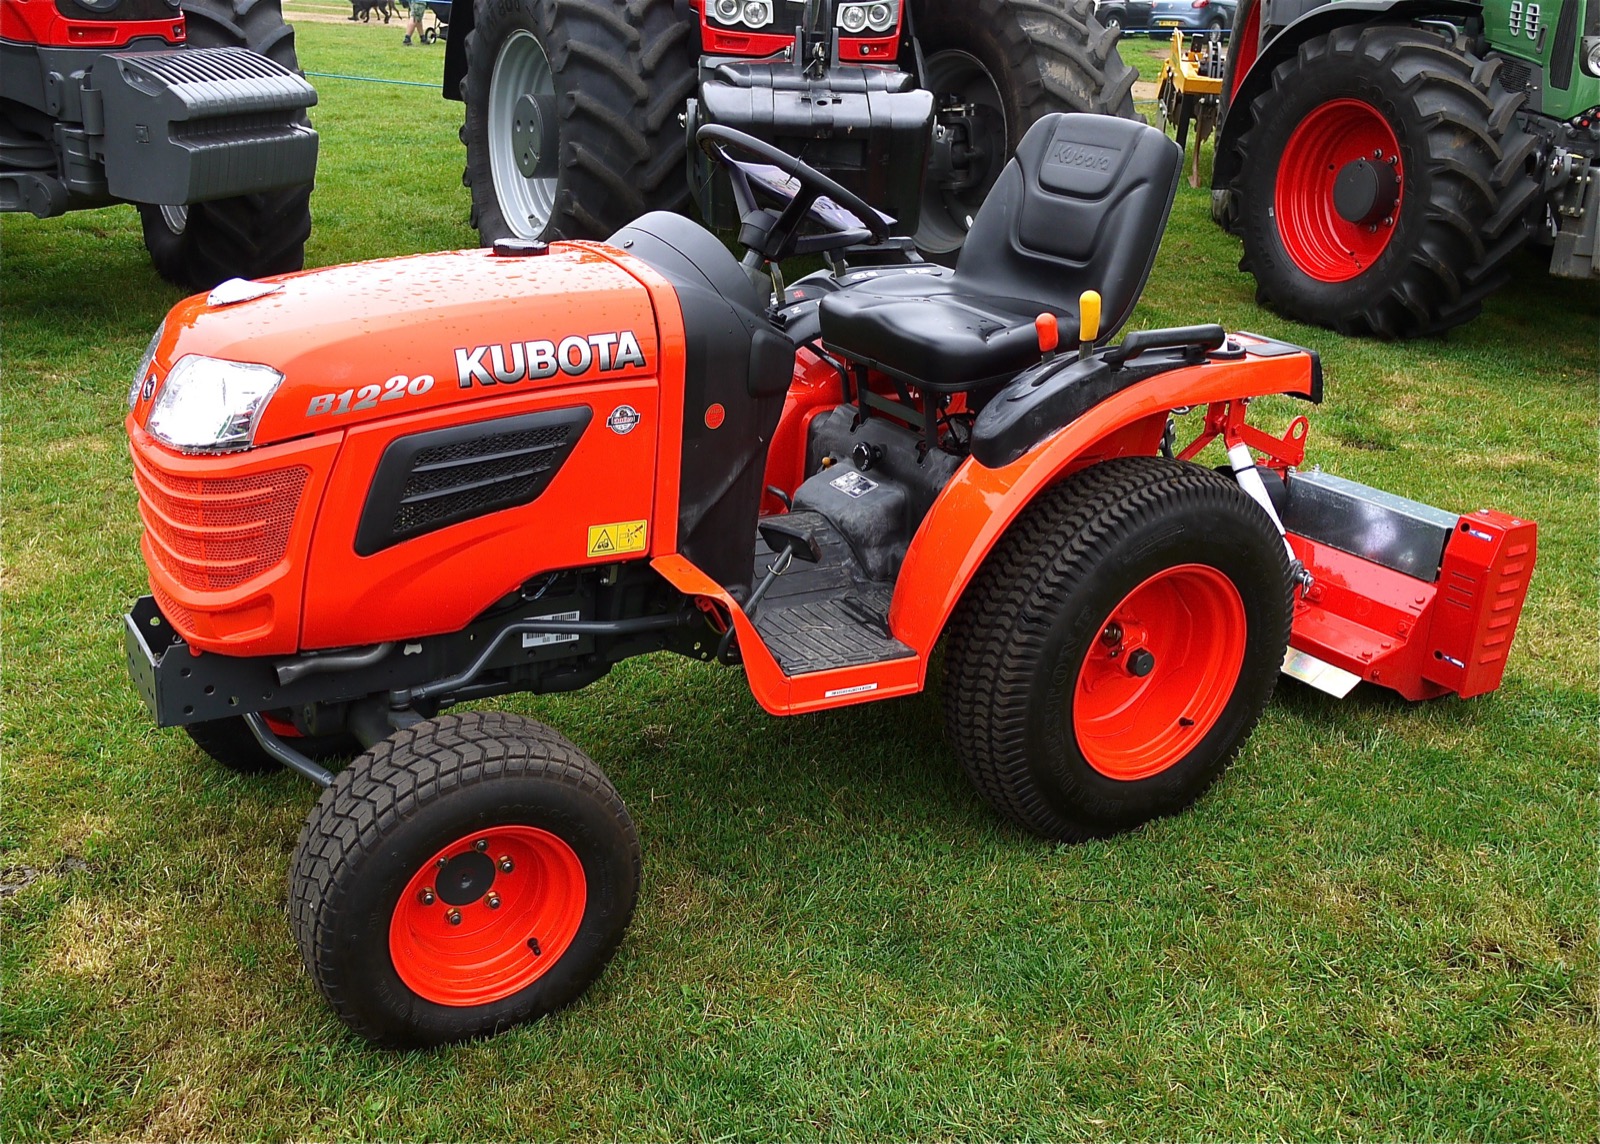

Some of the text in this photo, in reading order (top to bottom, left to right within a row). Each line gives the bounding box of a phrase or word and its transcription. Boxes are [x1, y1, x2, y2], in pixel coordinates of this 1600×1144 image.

[1054, 144, 1110, 171] Kubota
[454, 330, 646, 388] KUBOTA
[305, 374, 435, 417] B1220
